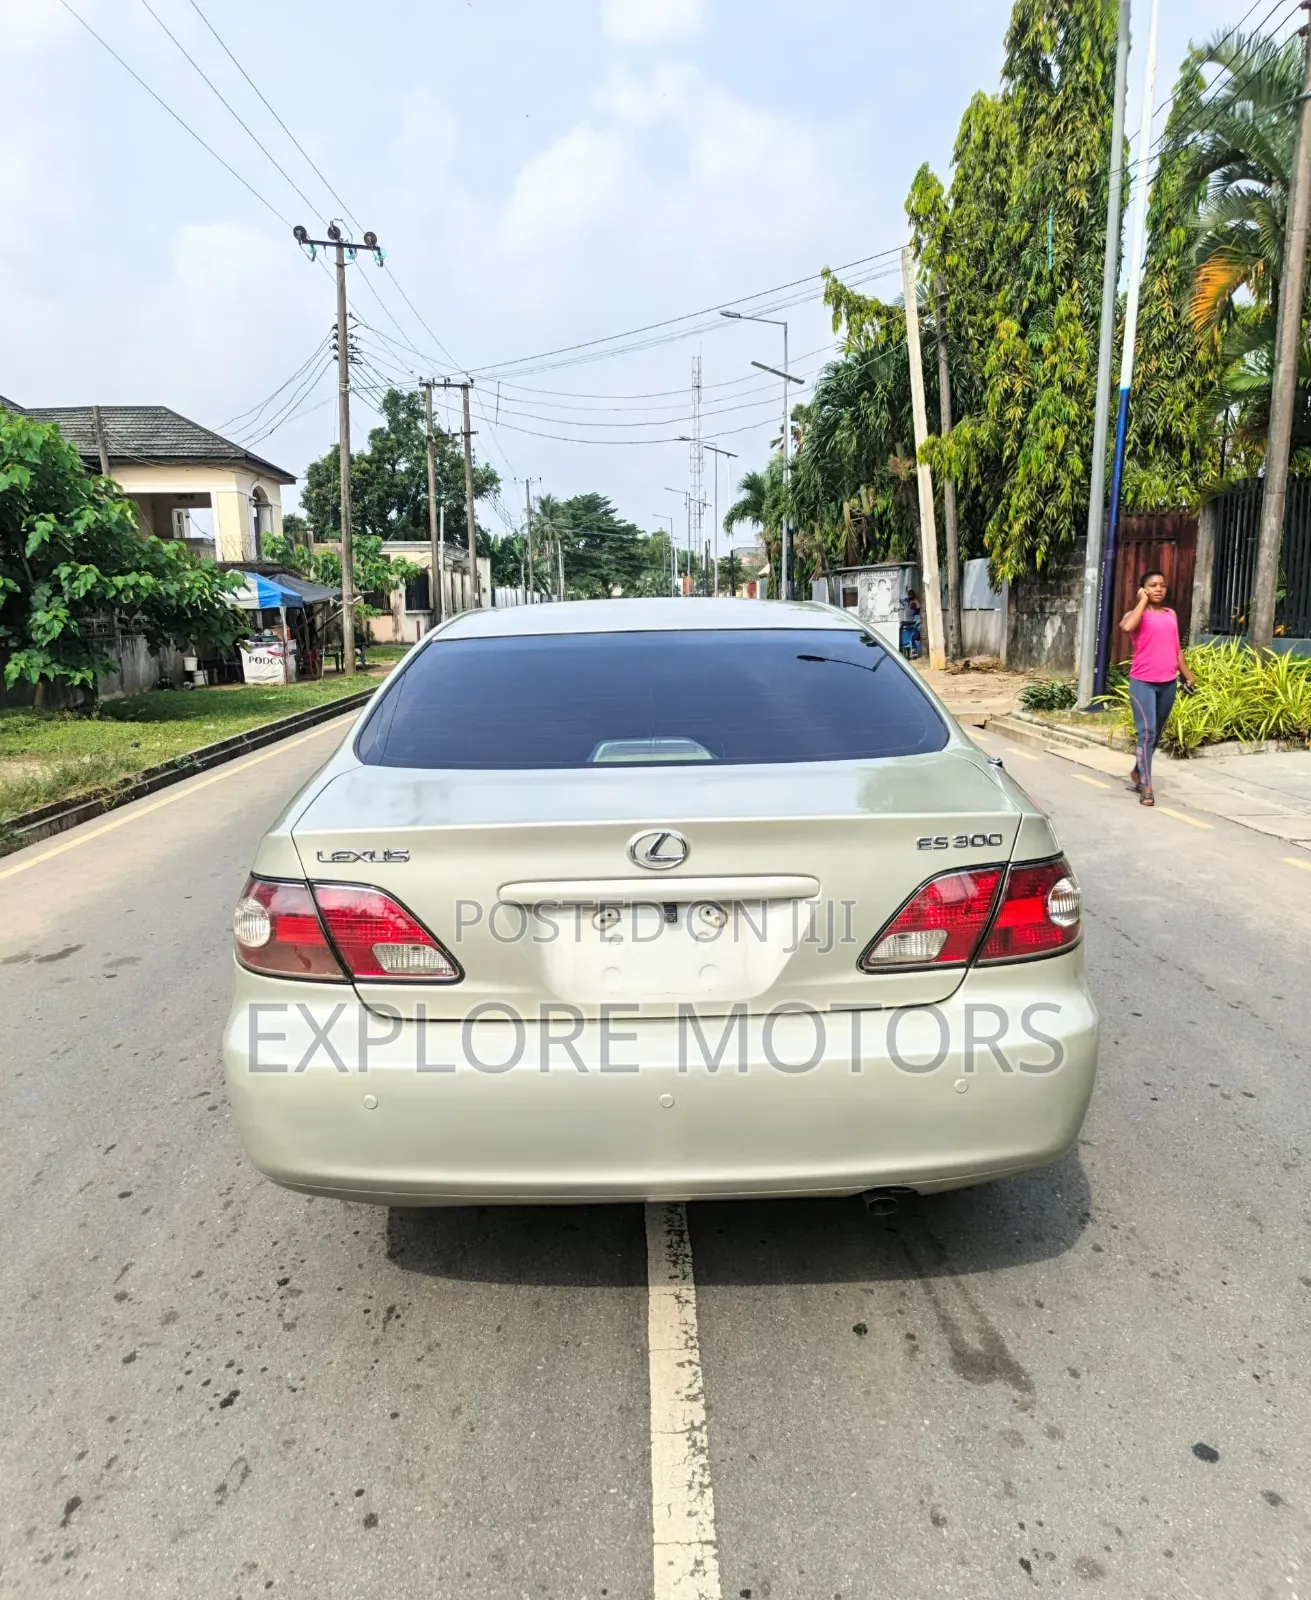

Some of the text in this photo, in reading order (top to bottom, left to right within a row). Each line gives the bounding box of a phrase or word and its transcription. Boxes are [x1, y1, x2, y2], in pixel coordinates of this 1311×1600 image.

[916, 833, 1003, 850] ES 300
[316, 848, 411, 863] LEXUS
